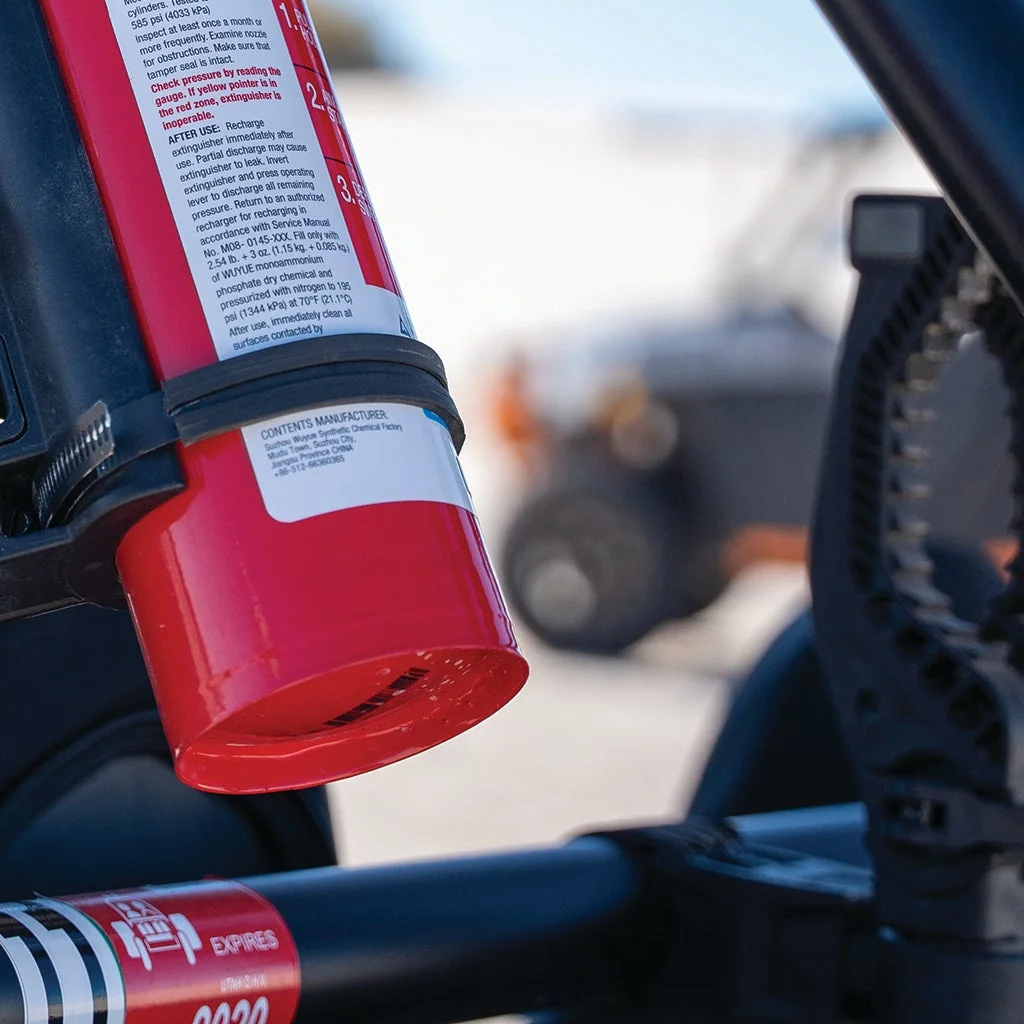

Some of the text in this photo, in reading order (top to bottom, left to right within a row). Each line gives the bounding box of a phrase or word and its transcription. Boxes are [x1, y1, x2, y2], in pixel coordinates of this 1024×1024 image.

[128, 2, 169, 18] cylinders.
[131, 6, 211, 31] 585 psi (4033 kPa)
[279, 2, 298, 31] 1.
[136, 27, 168, 44] Inspect
[168, 25, 179, 35] at
[178, 21, 201, 33] least
[201, 20, 222, 29] once
[223, 19, 230, 27] a
[230, 18, 255, 26] month
[140, 30, 268, 56] more frequently. Examine nozzle
[143, 42, 271, 68] for obstructions. Make sure that
[147, 65, 178, 81] tamper
[180, 60, 199, 72] seal
[199, 59, 208, 67] is
[151, 67, 282, 94] Check pressure by reading the
[155, 79, 278, 108] gauge. If yellow pointer is in
[159, 91, 282, 119] the red zone, extinguisher is
[306, 82, 325, 111] 2.
[162, 111, 215, 131] inoperable.
[169, 120, 265, 146] AFTER USE: Recharge
[172, 130, 294, 158] extinguisher immediately after
[176, 144, 308, 170] use. Partial discharge may cause
[180, 163, 232, 183] extinguisher
[234, 161, 244, 170] to
[266, 156, 290, 165] Invert
[184, 169, 316, 196] extinguisher and press operating
[187, 180, 316, 208] lever to discharge all remaining
[337, 174, 356, 204] 3.
[192, 193, 325, 222] pressure. Return to an authorized
[196, 205, 308, 233] recharger for recharging in
[200, 218, 331, 246] accordance with Service Manual
[204, 249, 220, 259] No.
[293, 231, 307, 241] Fill
[307, 231, 323, 241] only
[324, 232, 340, 240] with
[208, 257, 227, 271] 2.54
[228, 255, 240, 264] lb.
[250, 250, 257, 259] 3
[272, 244, 294, 257] (1.15
[316, 242, 338, 251] 0.085
[212, 255, 324, 283] of WUYUE monoammonium
[216, 269, 333, 299] phosphate dry chemical and
[220, 282, 352, 311] pressurized with nitrogen to 195
[225, 312, 238, 325] psi
[240, 305, 266, 320] (1344
[267, 300, 288, 312] kPa)
[289, 299, 299, 308] at
[299, 295, 319, 306] 70°F
[230, 326, 249, 337] After
[271, 311, 321, 327] immediately
[322, 310, 344, 319] clean
[344, 309, 353, 318] all
[233, 324, 323, 351] surfaces contacted by
[261, 410, 389, 440] CONTENTS MANUFACTURER:
[210, 929, 279, 956] EXPIRES
